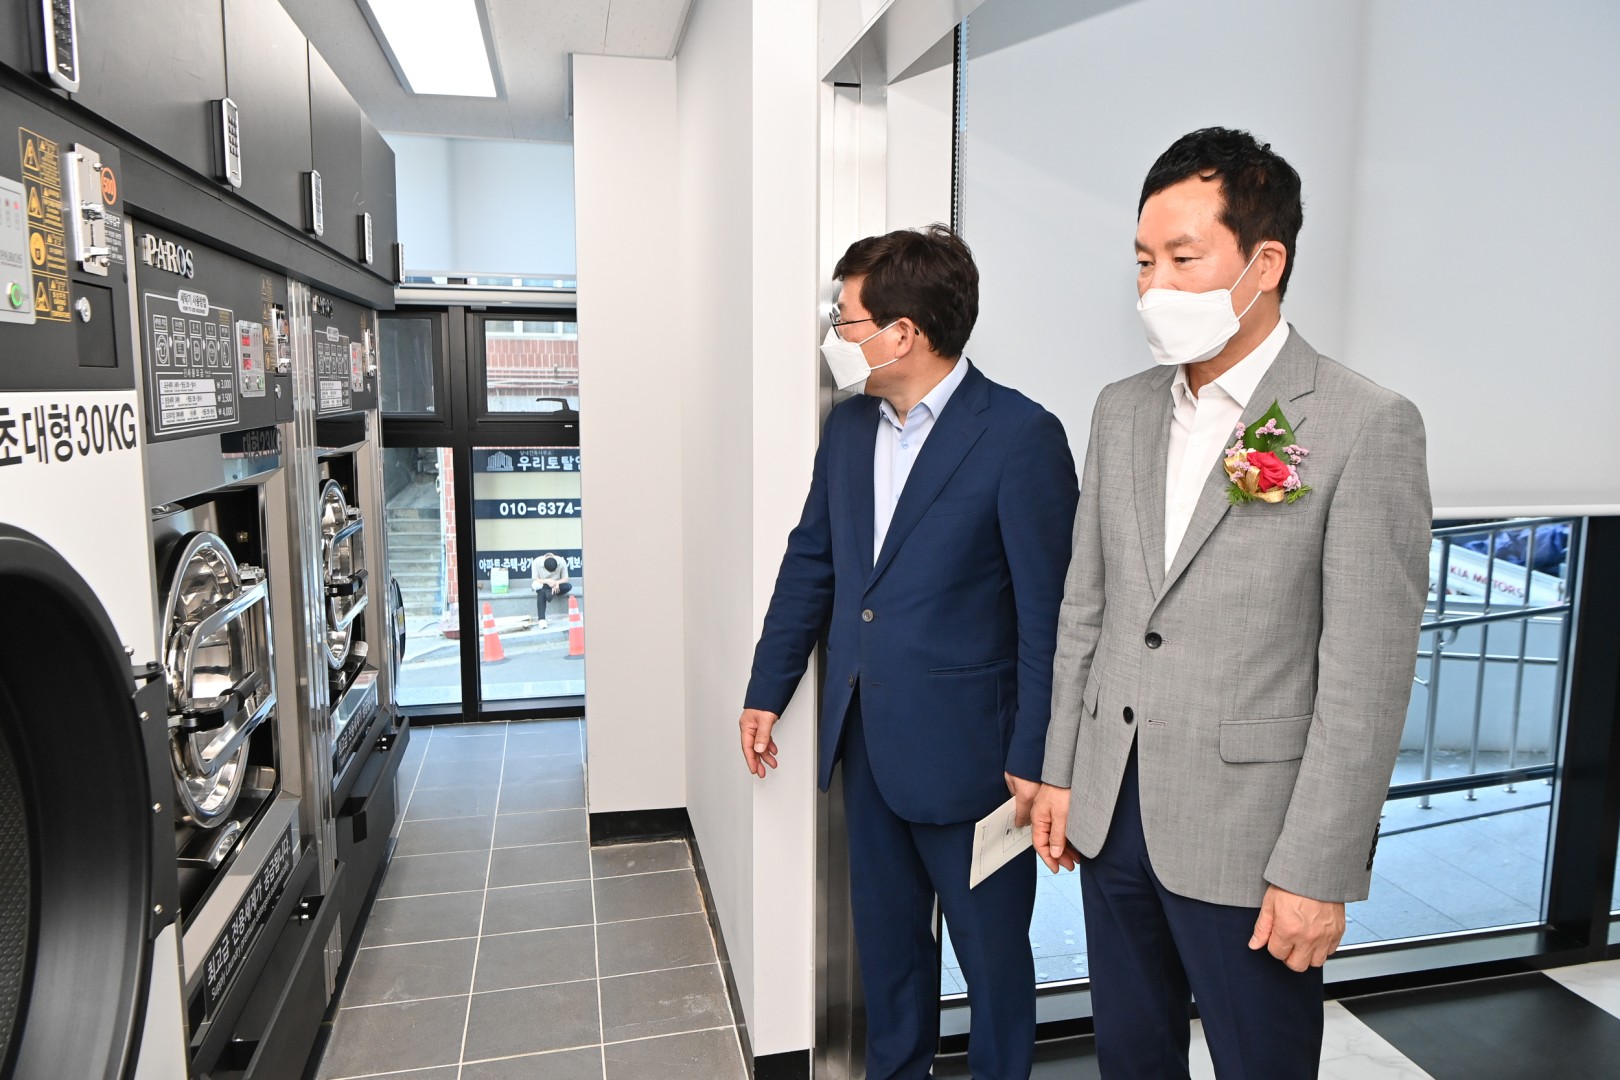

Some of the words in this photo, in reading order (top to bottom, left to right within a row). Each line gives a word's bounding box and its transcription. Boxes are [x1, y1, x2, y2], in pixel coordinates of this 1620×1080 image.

[143, 233, 195, 279] PAROS
[0, 403, 137, 466] 초대형30KG
[566, 556, 583, 570] 개보
[1450, 565, 1469, 579] KIA
[207, 934, 230, 987] 최고급
[231, 877, 263, 946] 전용세제가
[263, 833, 291, 891] 공급됩니다.
[211, 974, 226, 1001] Supply
